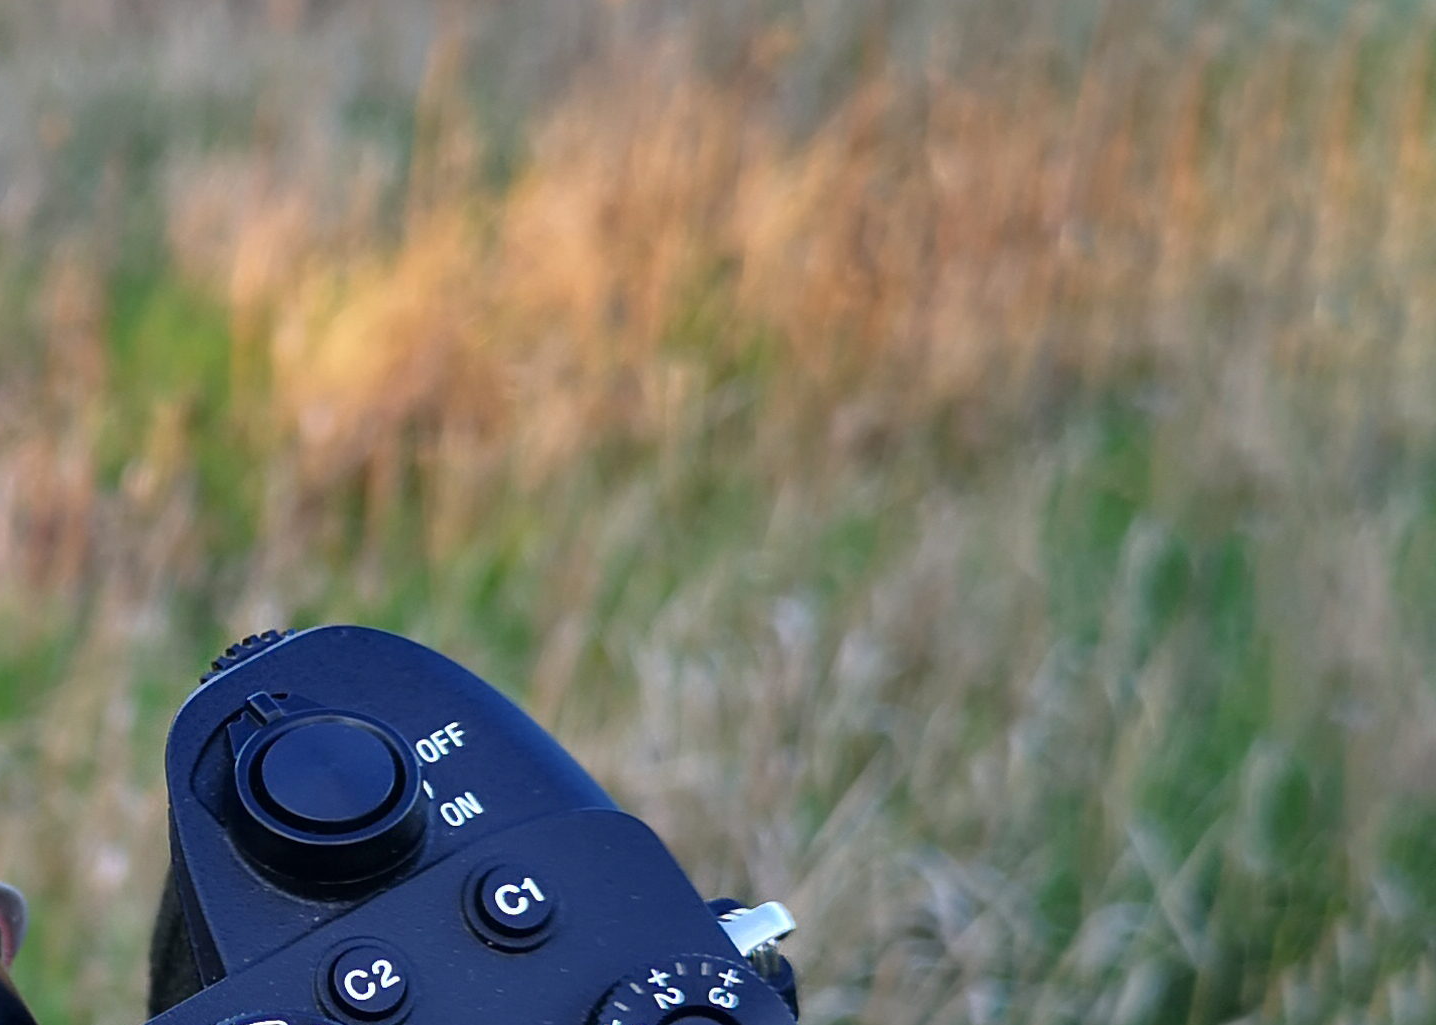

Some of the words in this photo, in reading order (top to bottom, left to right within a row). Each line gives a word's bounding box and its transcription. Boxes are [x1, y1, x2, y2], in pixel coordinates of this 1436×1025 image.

[415, 721, 465, 763] OFF
[440, 791, 484, 827] ON
[494, 877, 545, 915] C1
[344, 959, 400, 1001] C2
